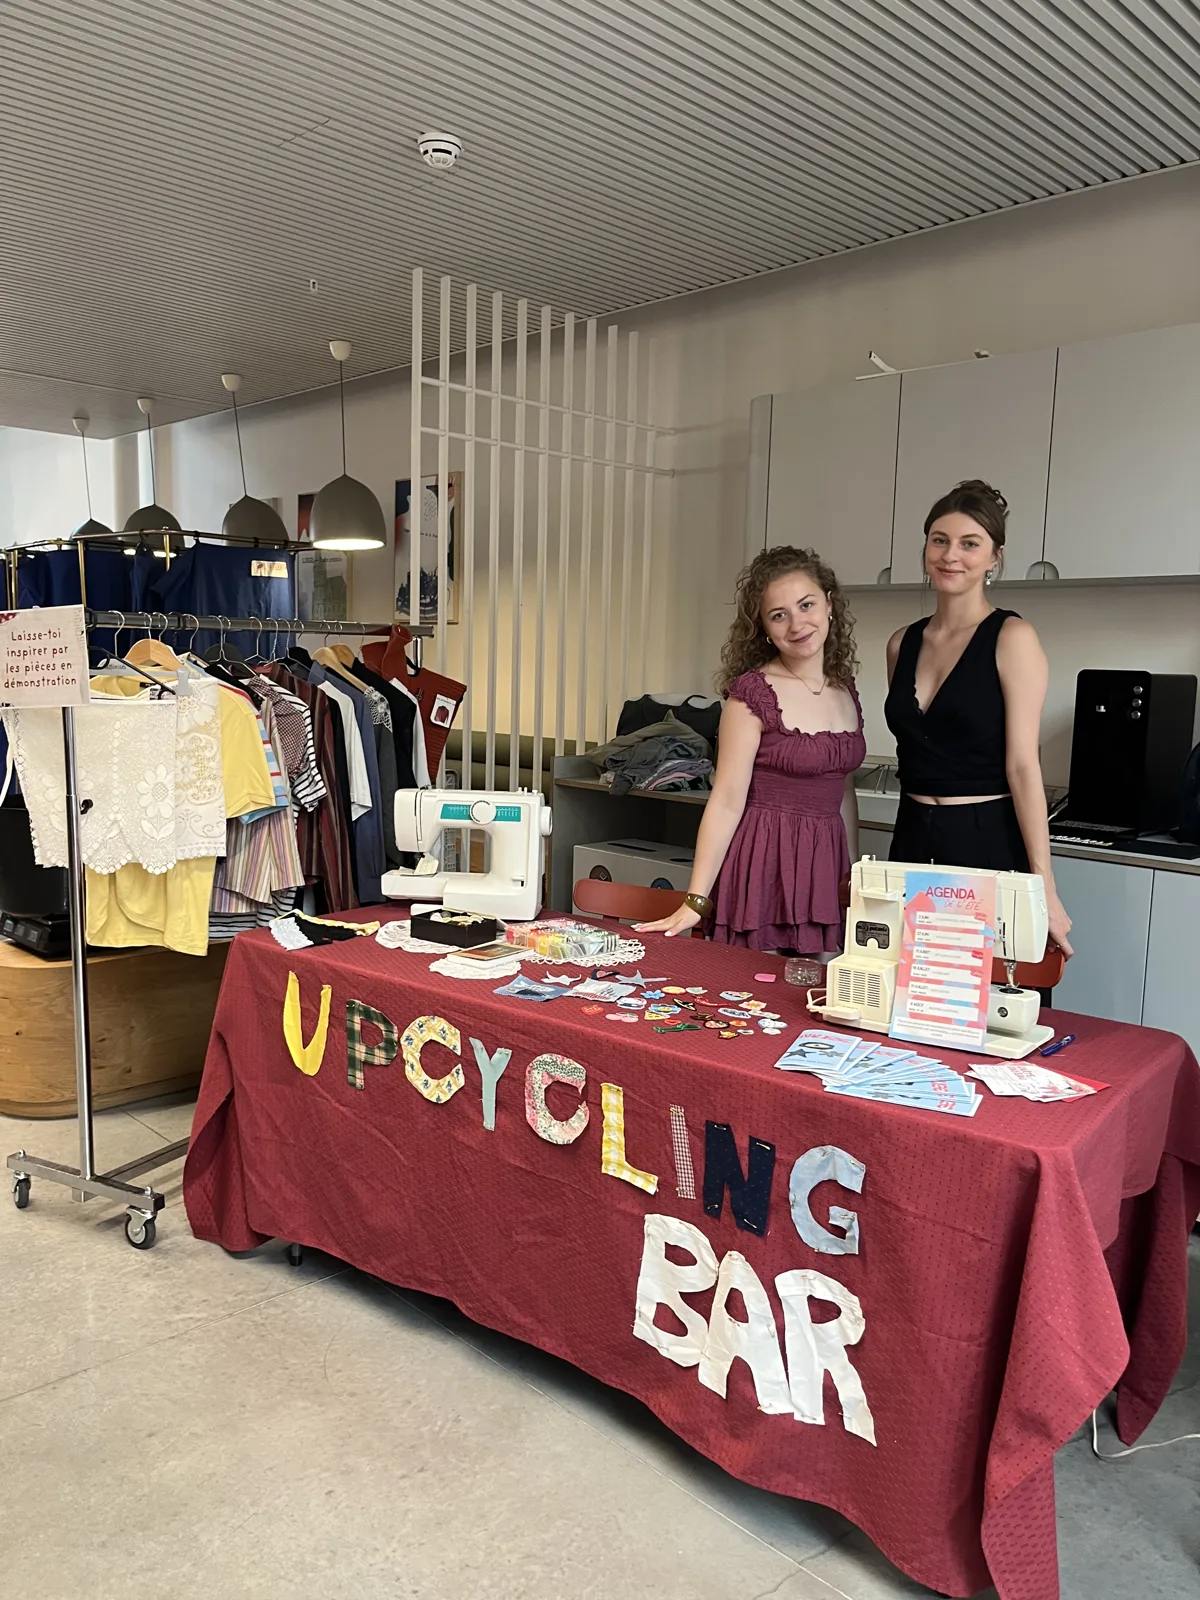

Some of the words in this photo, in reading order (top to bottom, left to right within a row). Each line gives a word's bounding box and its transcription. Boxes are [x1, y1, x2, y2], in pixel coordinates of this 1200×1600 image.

[11, 628, 61, 641] Laisse-toi
[6, 646, 48, 660] inspirer
[52, 646, 68, 658] par
[5, 663, 20, 674] les
[24, 661, 56, 675] pièces
[60, 662, 72, 670] en
[4, 676, 77, 689] démonstration
[925, 886, 976, 900] AGENDA
[283, 971, 866, 1255] UPCYCLING
[633, 1213, 878, 1447] BAR
